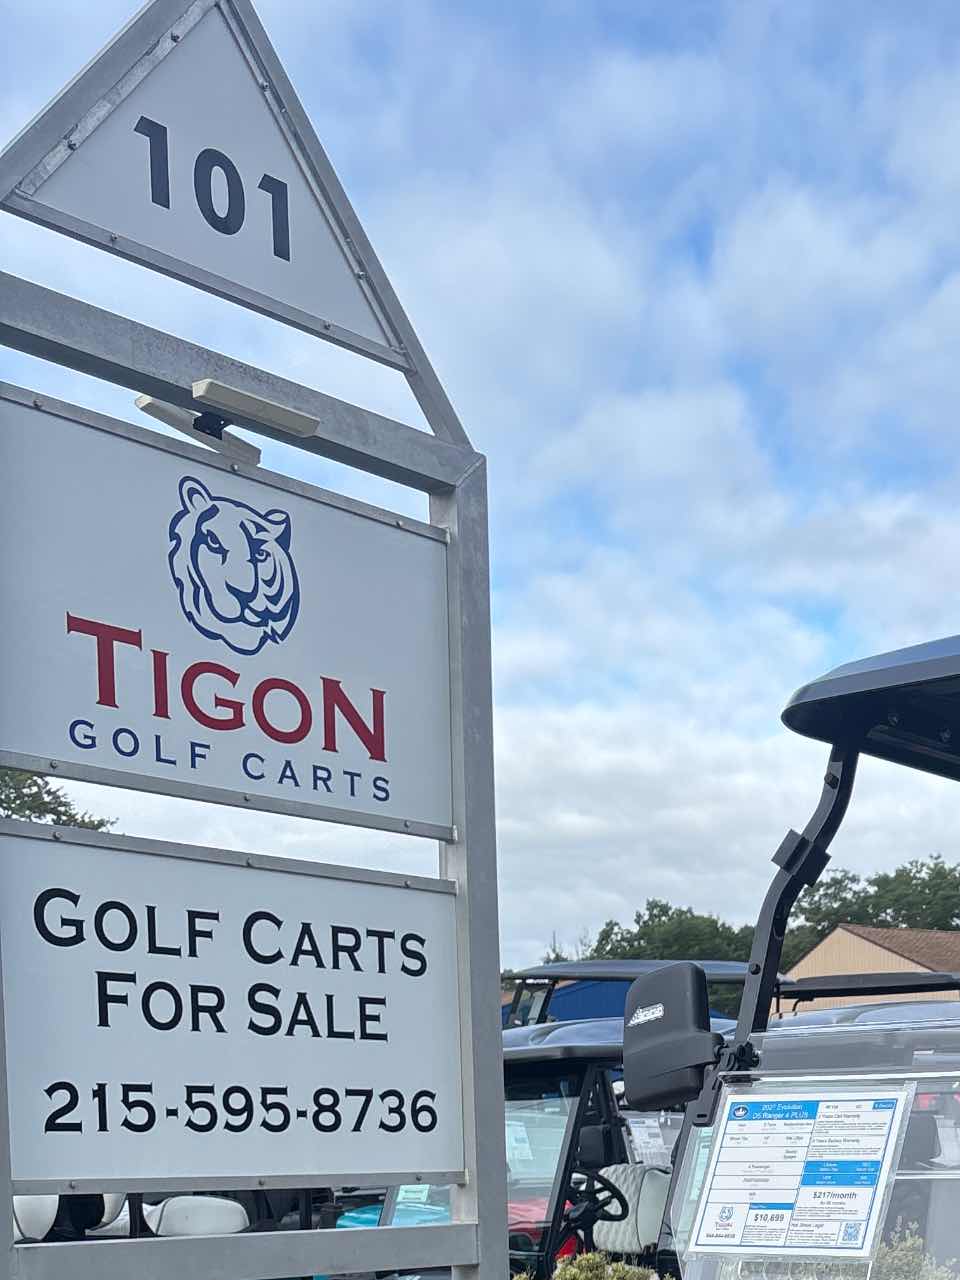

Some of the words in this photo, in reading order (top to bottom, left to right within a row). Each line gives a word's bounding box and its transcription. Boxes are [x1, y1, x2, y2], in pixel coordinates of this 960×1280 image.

[133, 115, 291, 262] 101
[66, 611, 388, 763] TIGON
[68, 719, 211, 770] GOLF
[242, 751, 391, 803] CARTS
[34, 887, 220, 958] GOLF
[242, 910, 428, 977] CARTS
[95, 970, 227, 1034] FOR
[247, 982, 389, 1042] SALE
[43, 1081, 438, 1134] 215-595-8736
[812, 1191, 857, 1200] $217/month
